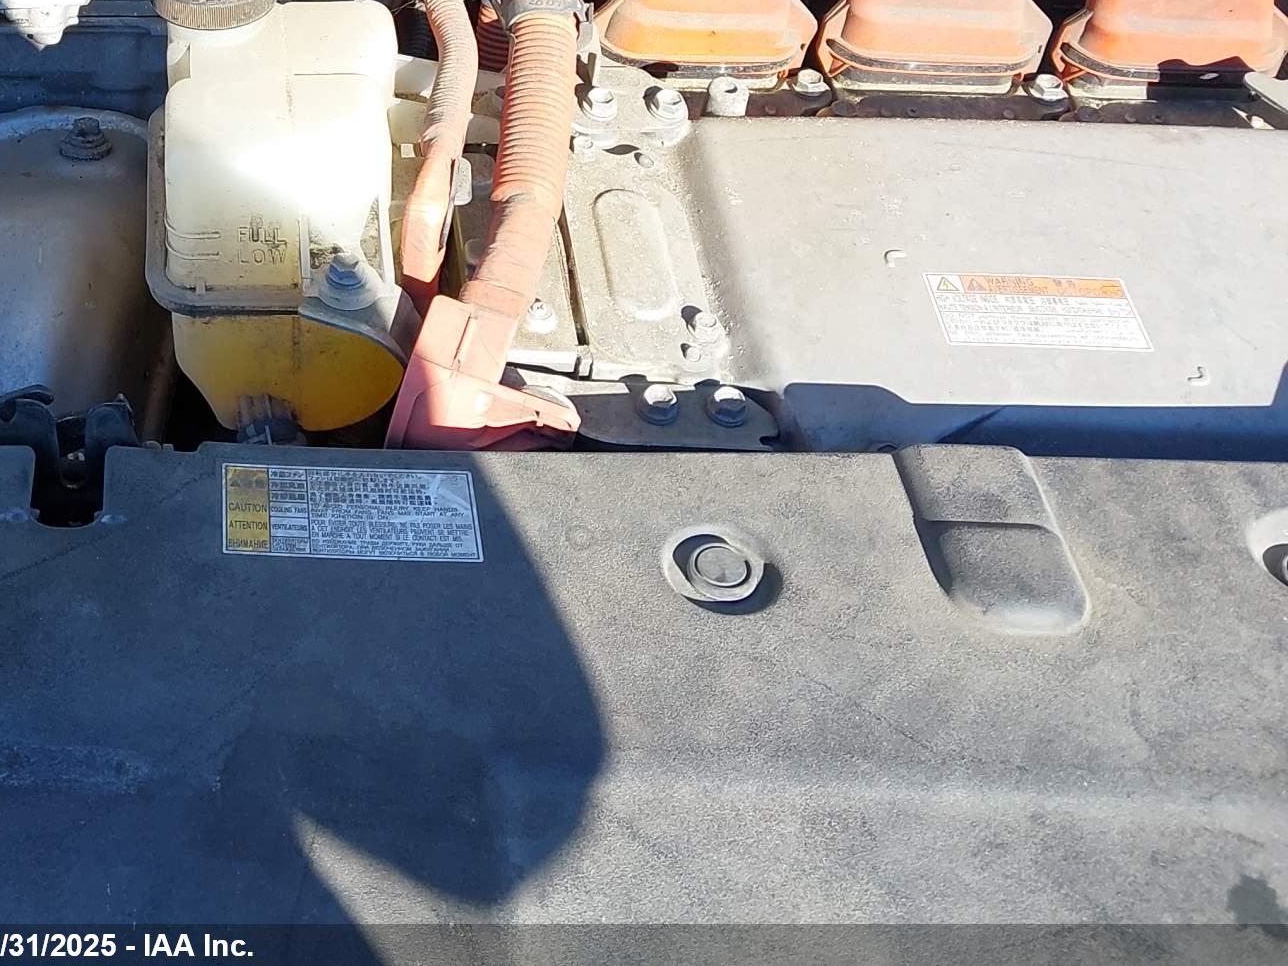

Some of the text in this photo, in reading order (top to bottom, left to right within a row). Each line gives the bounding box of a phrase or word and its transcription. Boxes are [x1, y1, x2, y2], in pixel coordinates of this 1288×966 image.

[237, 226, 288, 245] FULL
[237, 248, 287, 266] LOW
[229, 502, 268, 513] CAUTION
[229, 520, 268, 531] ATTENTION
[422, 522, 441, 530] POSER
[412, 534, 437, 542] CONTACT
